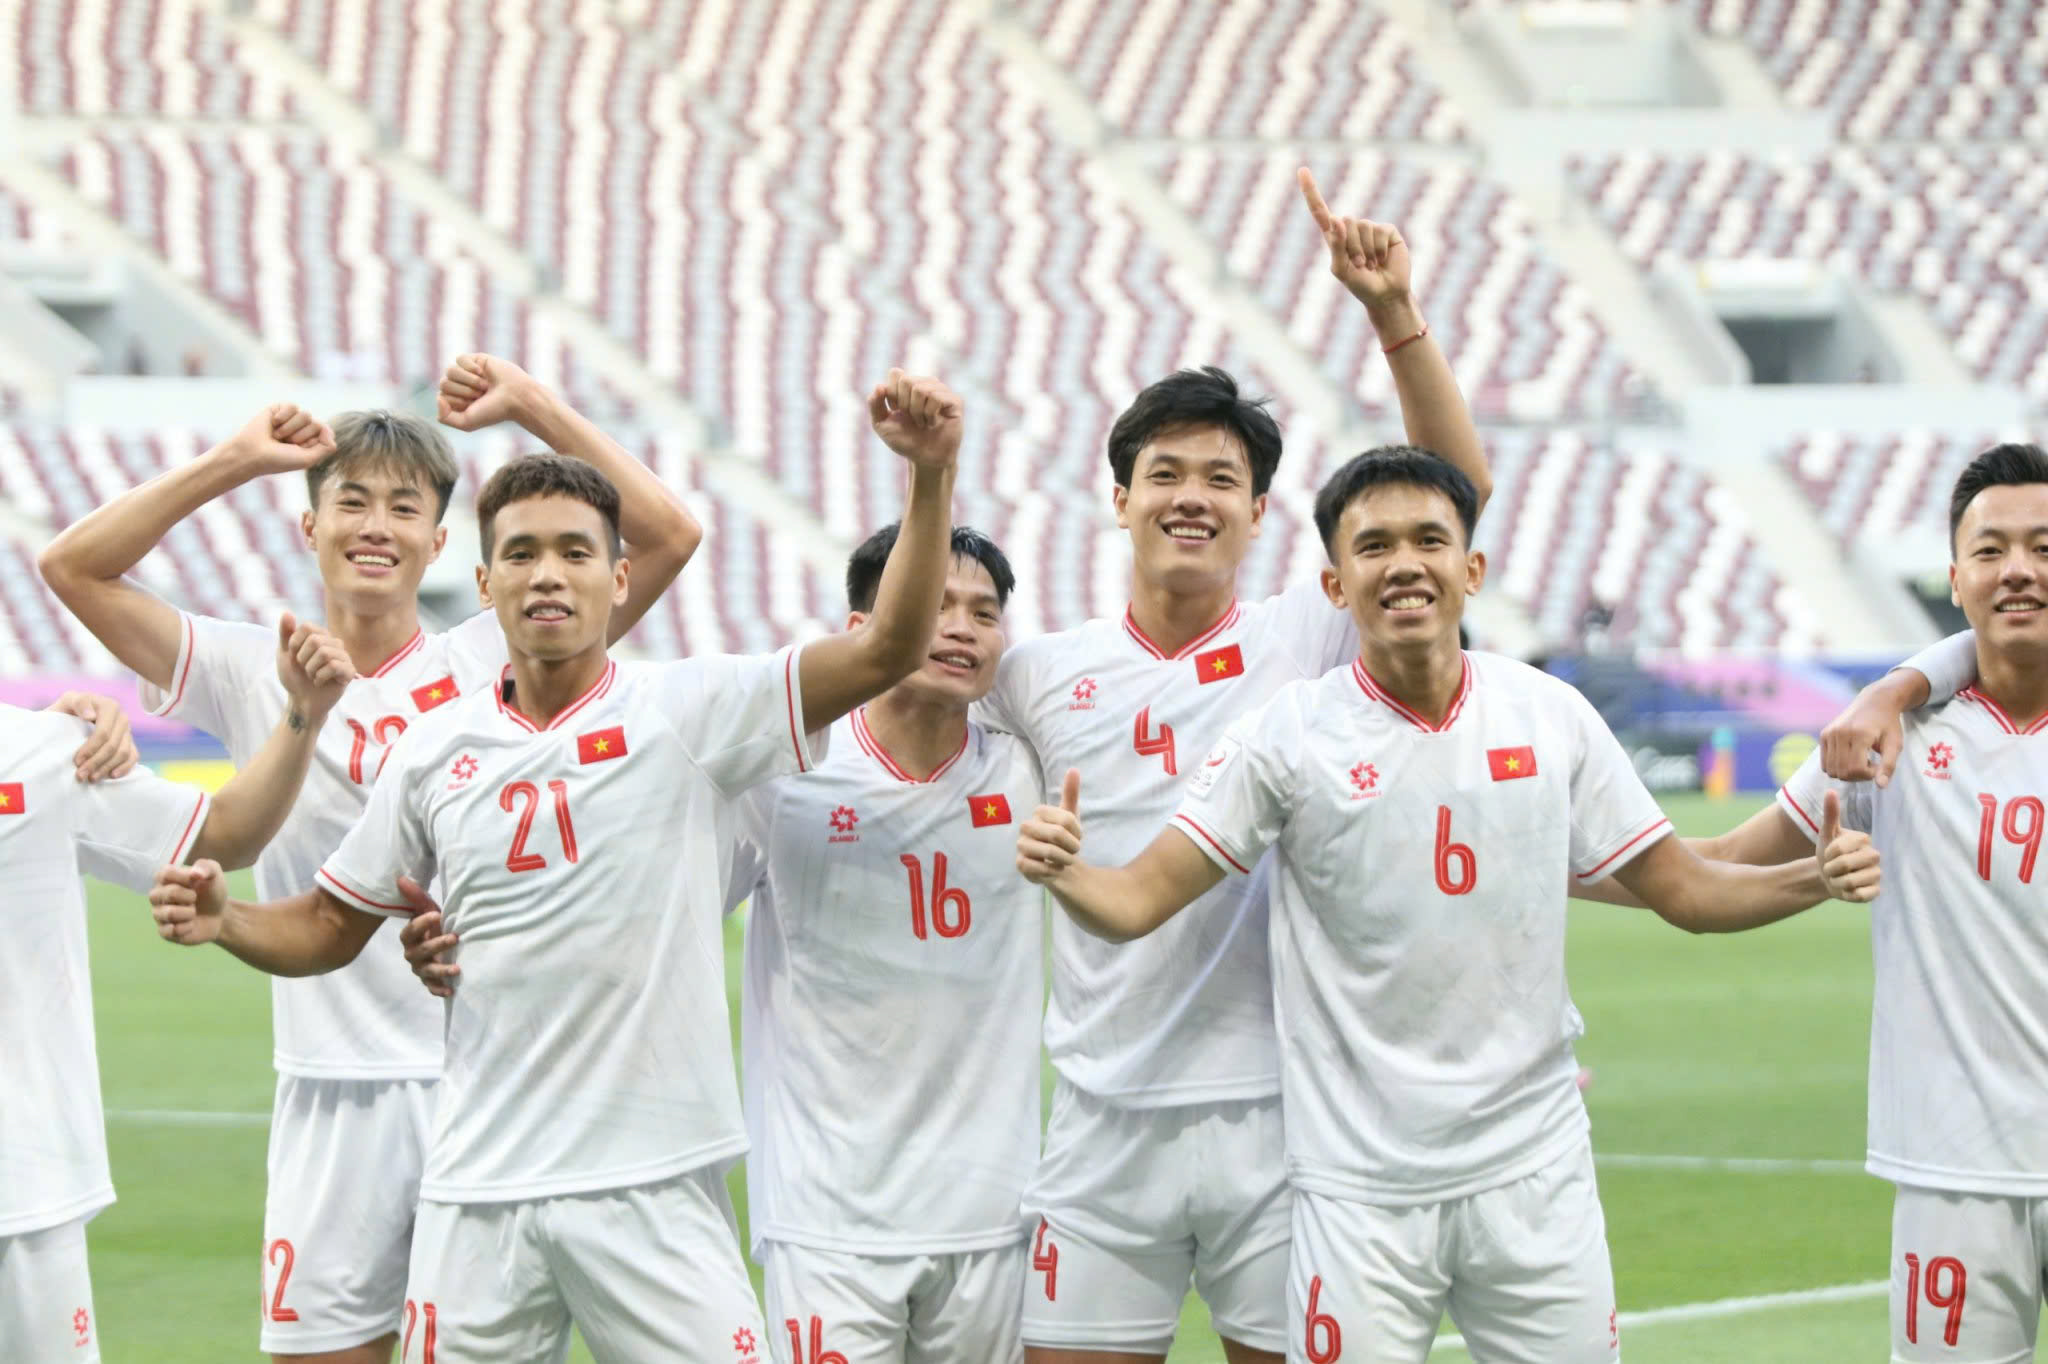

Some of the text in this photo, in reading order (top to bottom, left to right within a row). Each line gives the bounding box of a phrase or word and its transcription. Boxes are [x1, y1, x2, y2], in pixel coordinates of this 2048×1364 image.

[1133, 705, 1178, 777] 4
[499, 780, 578, 872] 21
[1434, 805, 1477, 896] 6
[1977, 793, 2046, 884] 19
[901, 852, 971, 940] 16
[263, 1238, 299, 1322] 2
[1033, 1217, 1058, 1301] 4
[1905, 1252, 1967, 1346] 19
[1304, 1275, 1342, 1364] 6
